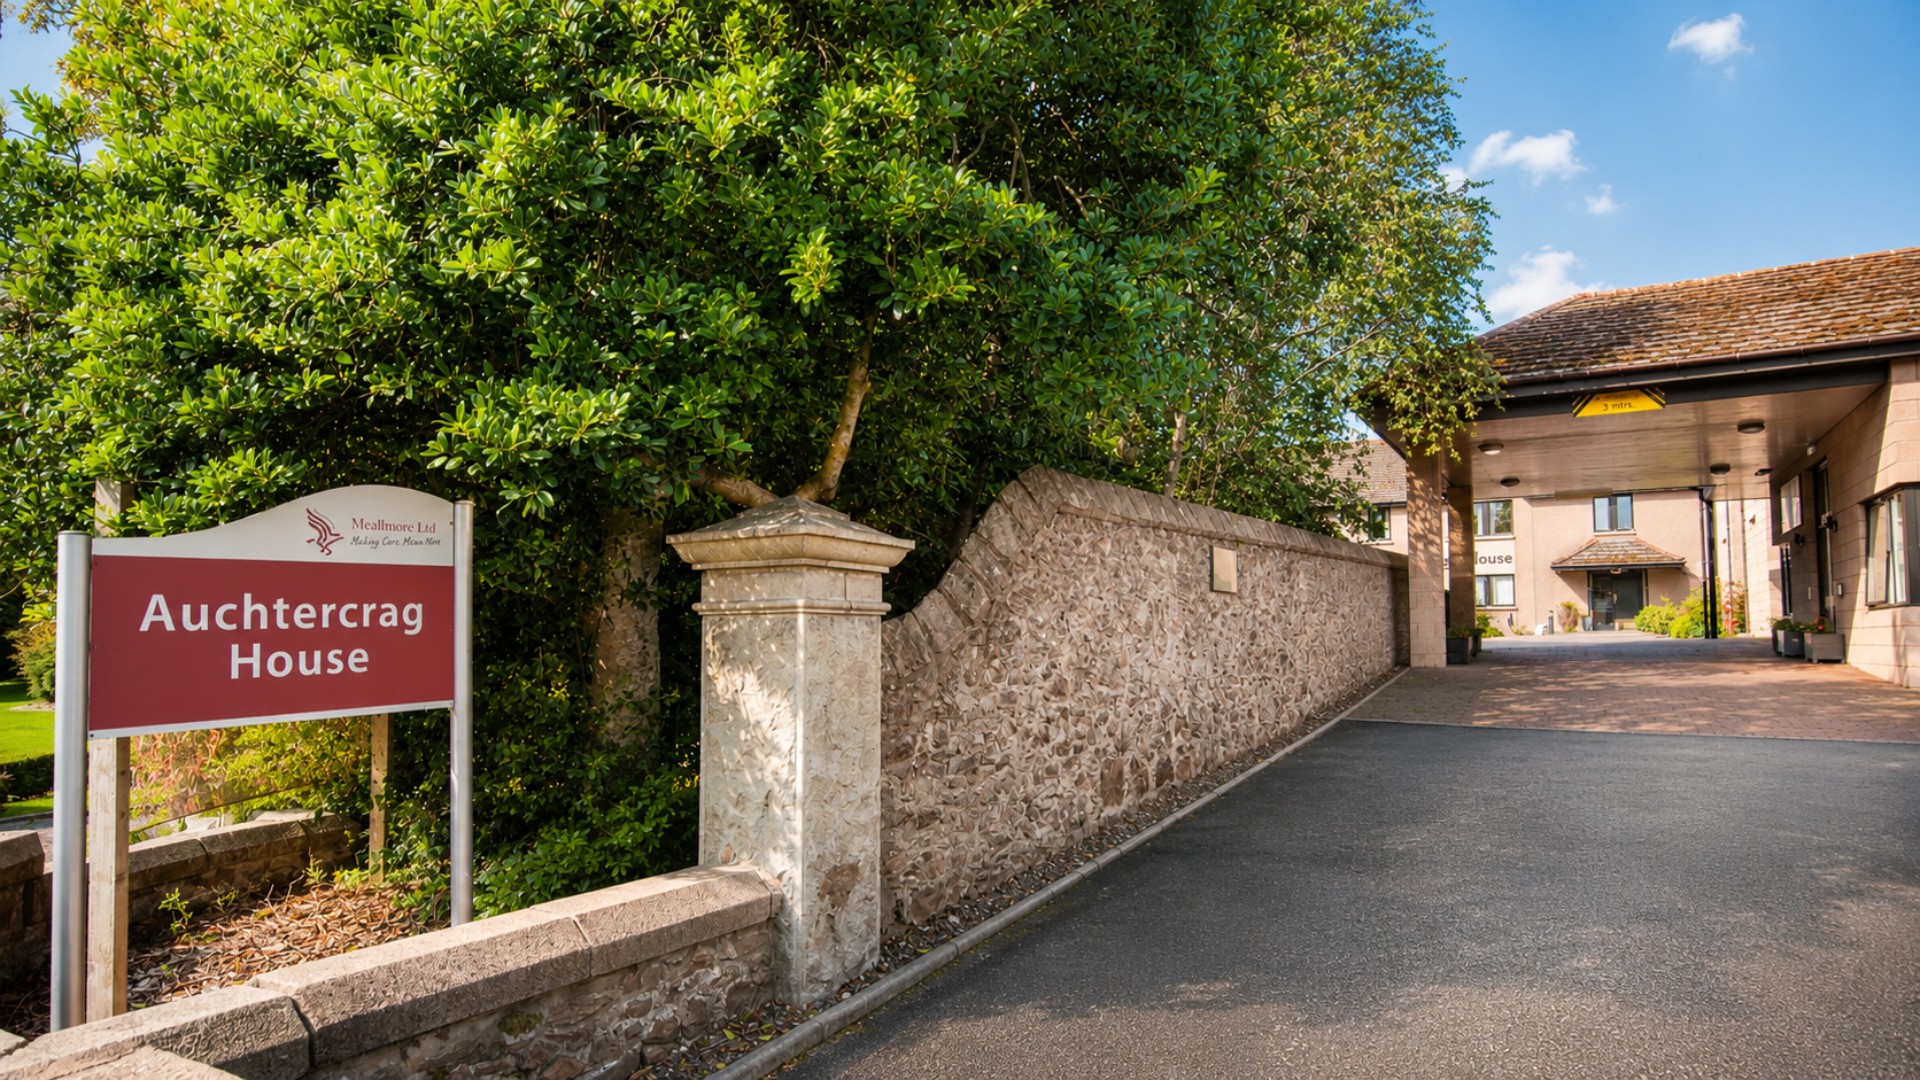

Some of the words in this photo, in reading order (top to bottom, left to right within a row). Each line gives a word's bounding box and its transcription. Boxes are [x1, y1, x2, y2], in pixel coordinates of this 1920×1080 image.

[352, 518, 415, 533] Meallmore
[418, 522, 436, 534] Ltd
[350, 536, 380, 550] Making
[139, 592, 424, 636] Auchtercrag
[230, 643, 370, 679] House
